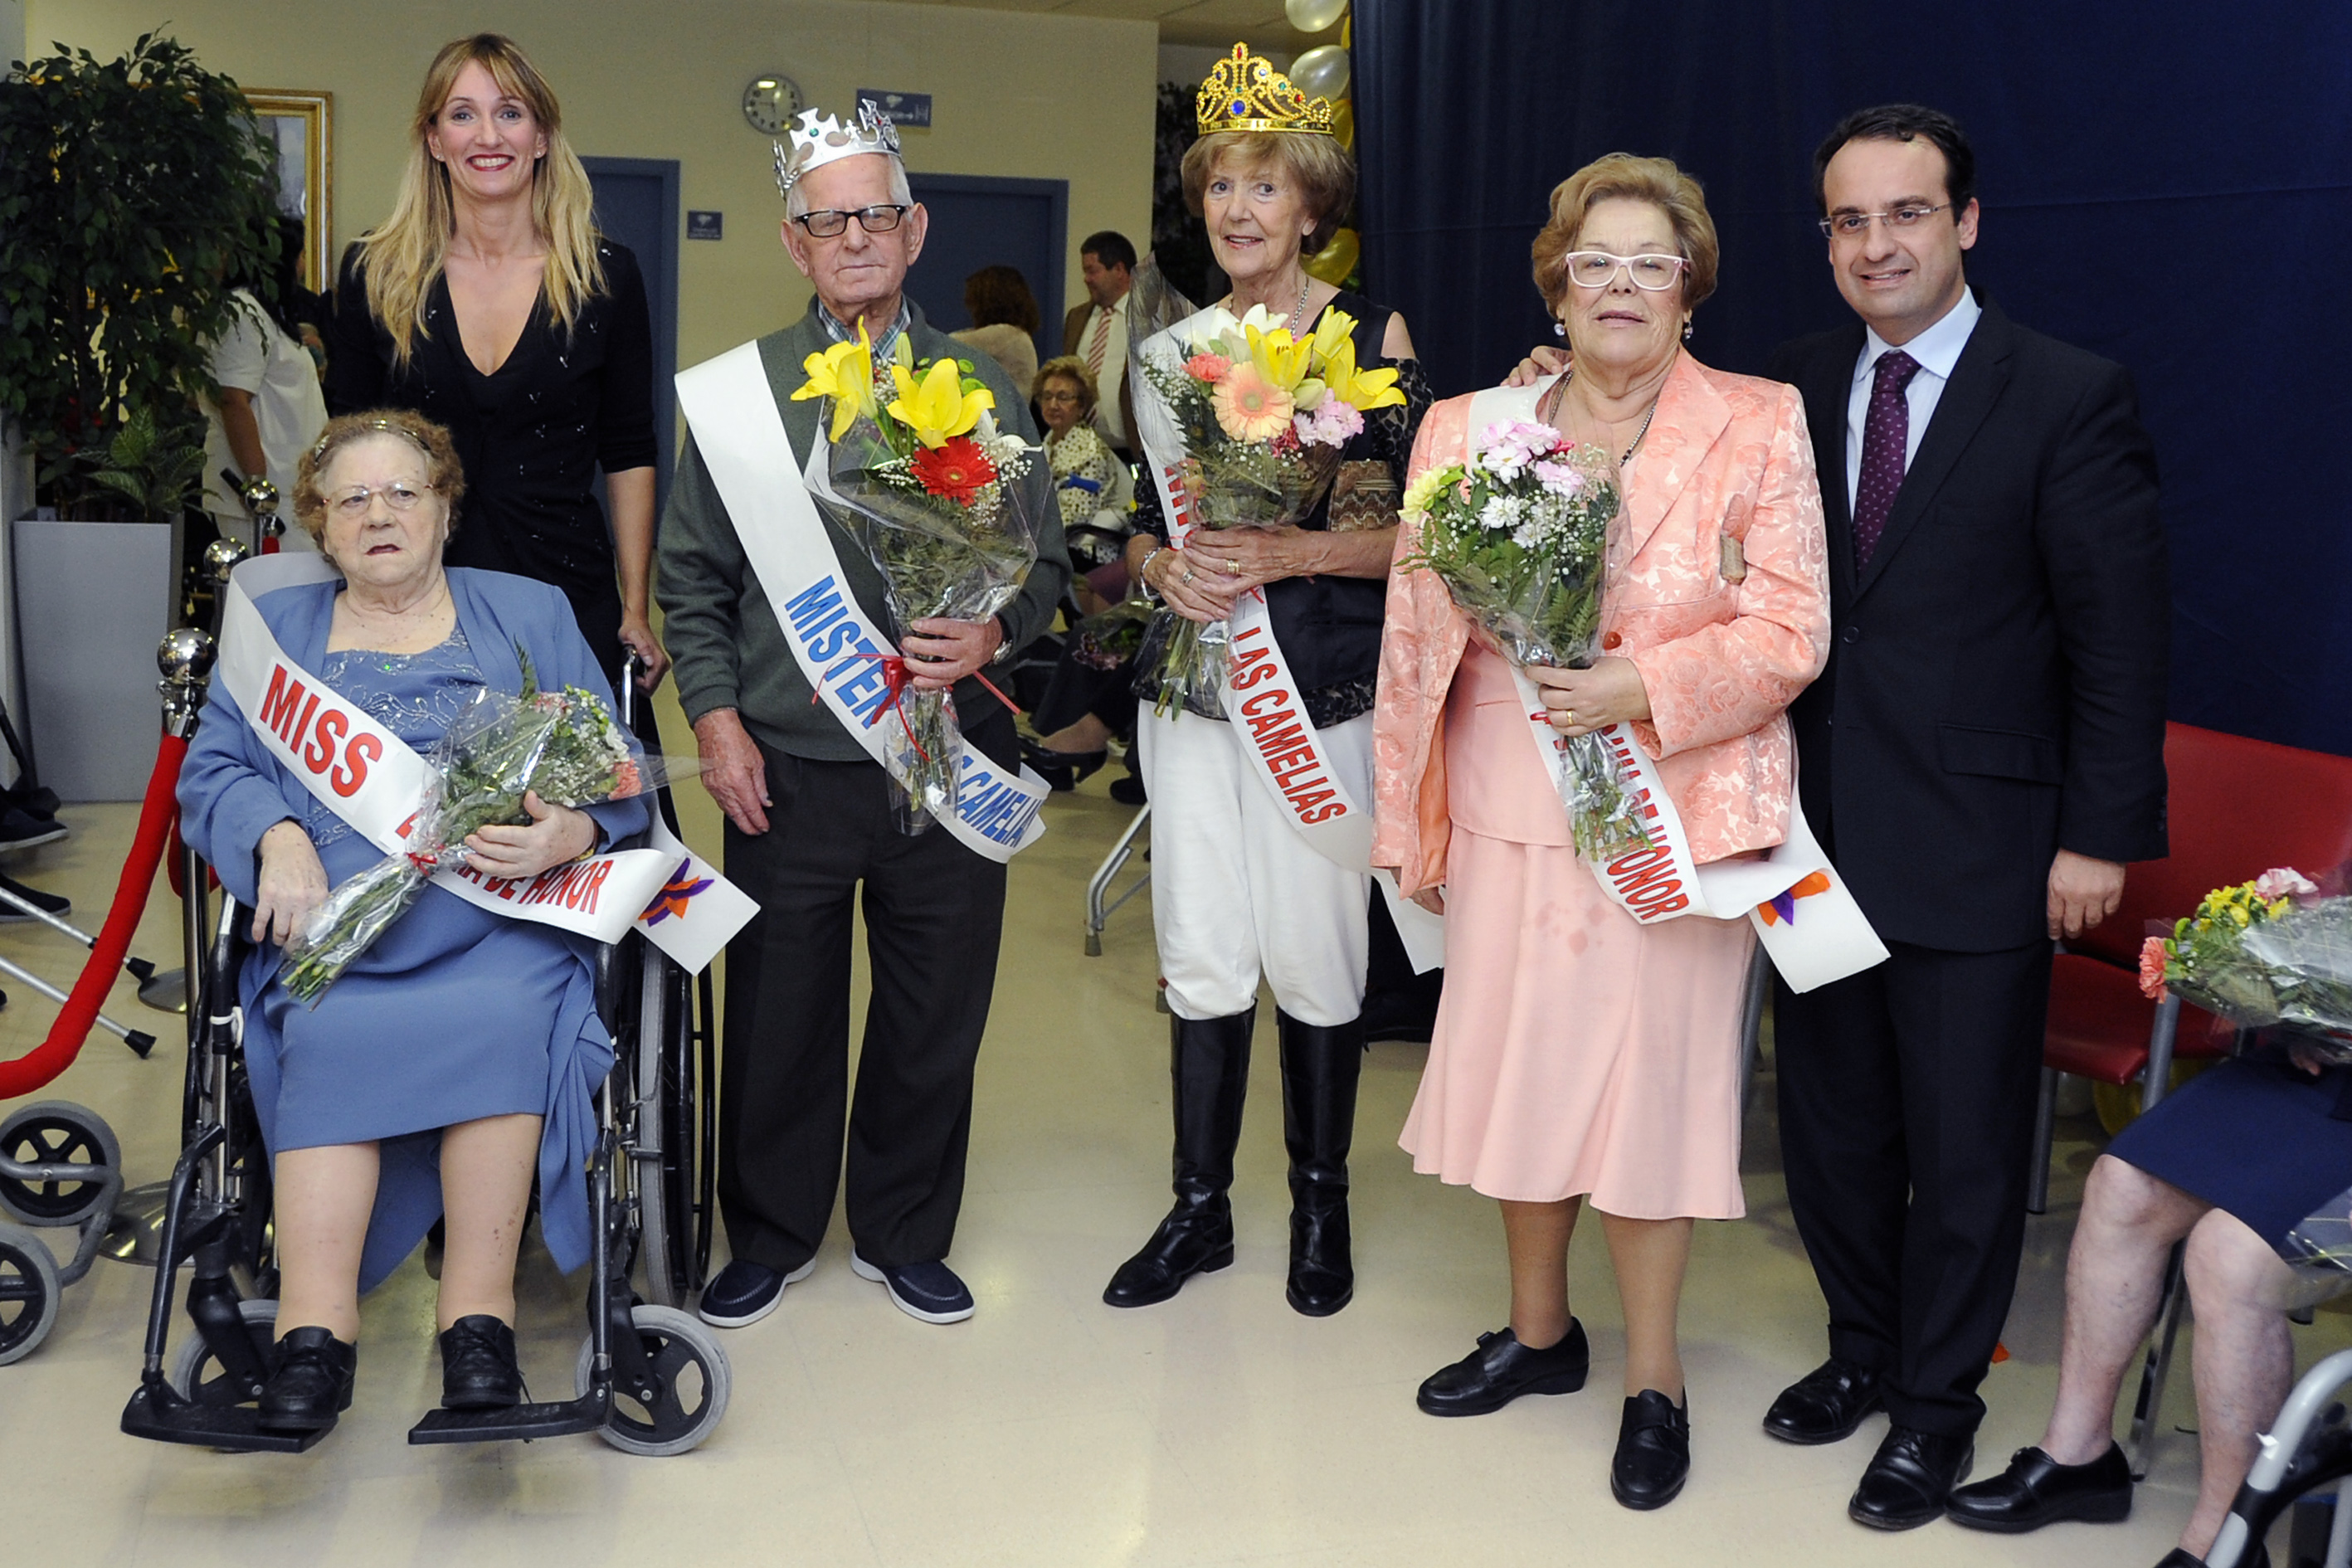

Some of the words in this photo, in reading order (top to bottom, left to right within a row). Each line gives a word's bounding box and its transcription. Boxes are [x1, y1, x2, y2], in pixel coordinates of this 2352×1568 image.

[260, 663, 383, 798] MISS
[518, 859, 614, 914] HONOR
[956, 771, 1043, 849] CAMELIA
[1241, 689, 1347, 825] CAMELIAS
